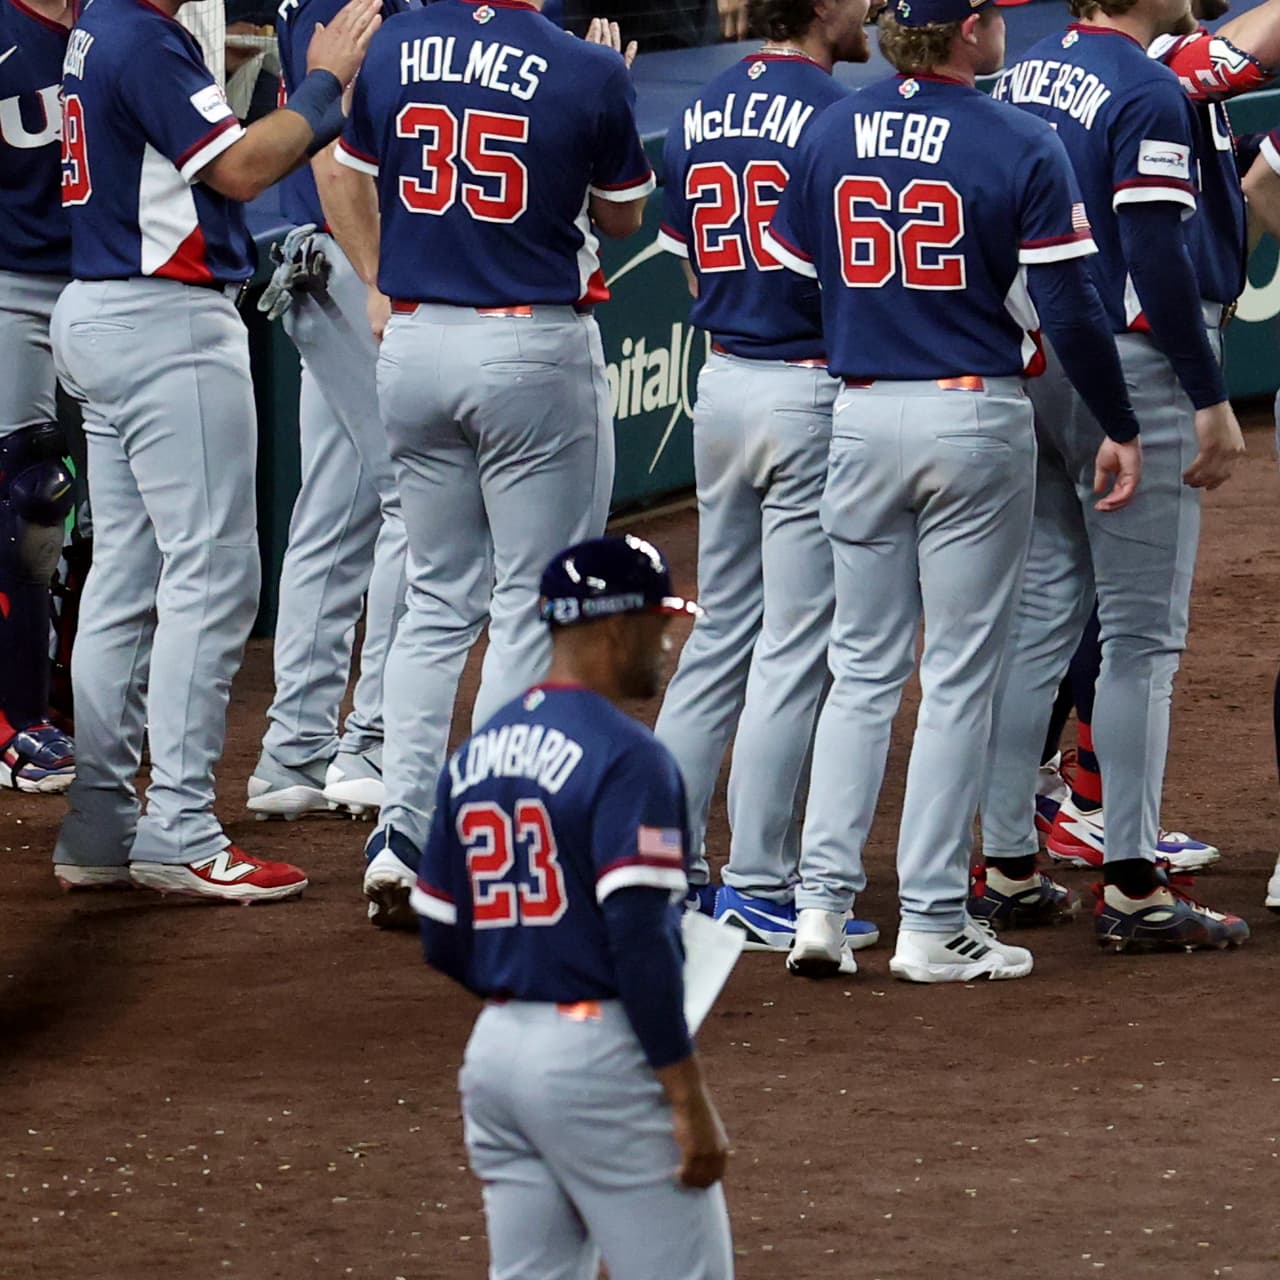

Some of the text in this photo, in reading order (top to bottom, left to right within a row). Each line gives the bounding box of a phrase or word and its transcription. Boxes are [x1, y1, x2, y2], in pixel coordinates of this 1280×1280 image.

[400, 36, 548, 101] HOLMES
[396, 102, 530, 224] 35
[684, 93, 813, 151] McLEAN
[854, 111, 951, 164] WEBB
[686, 160, 790, 273] 26
[834, 175, 967, 290] 62
[449, 724, 583, 798] LOMBARD
[456, 798, 568, 930] 23
